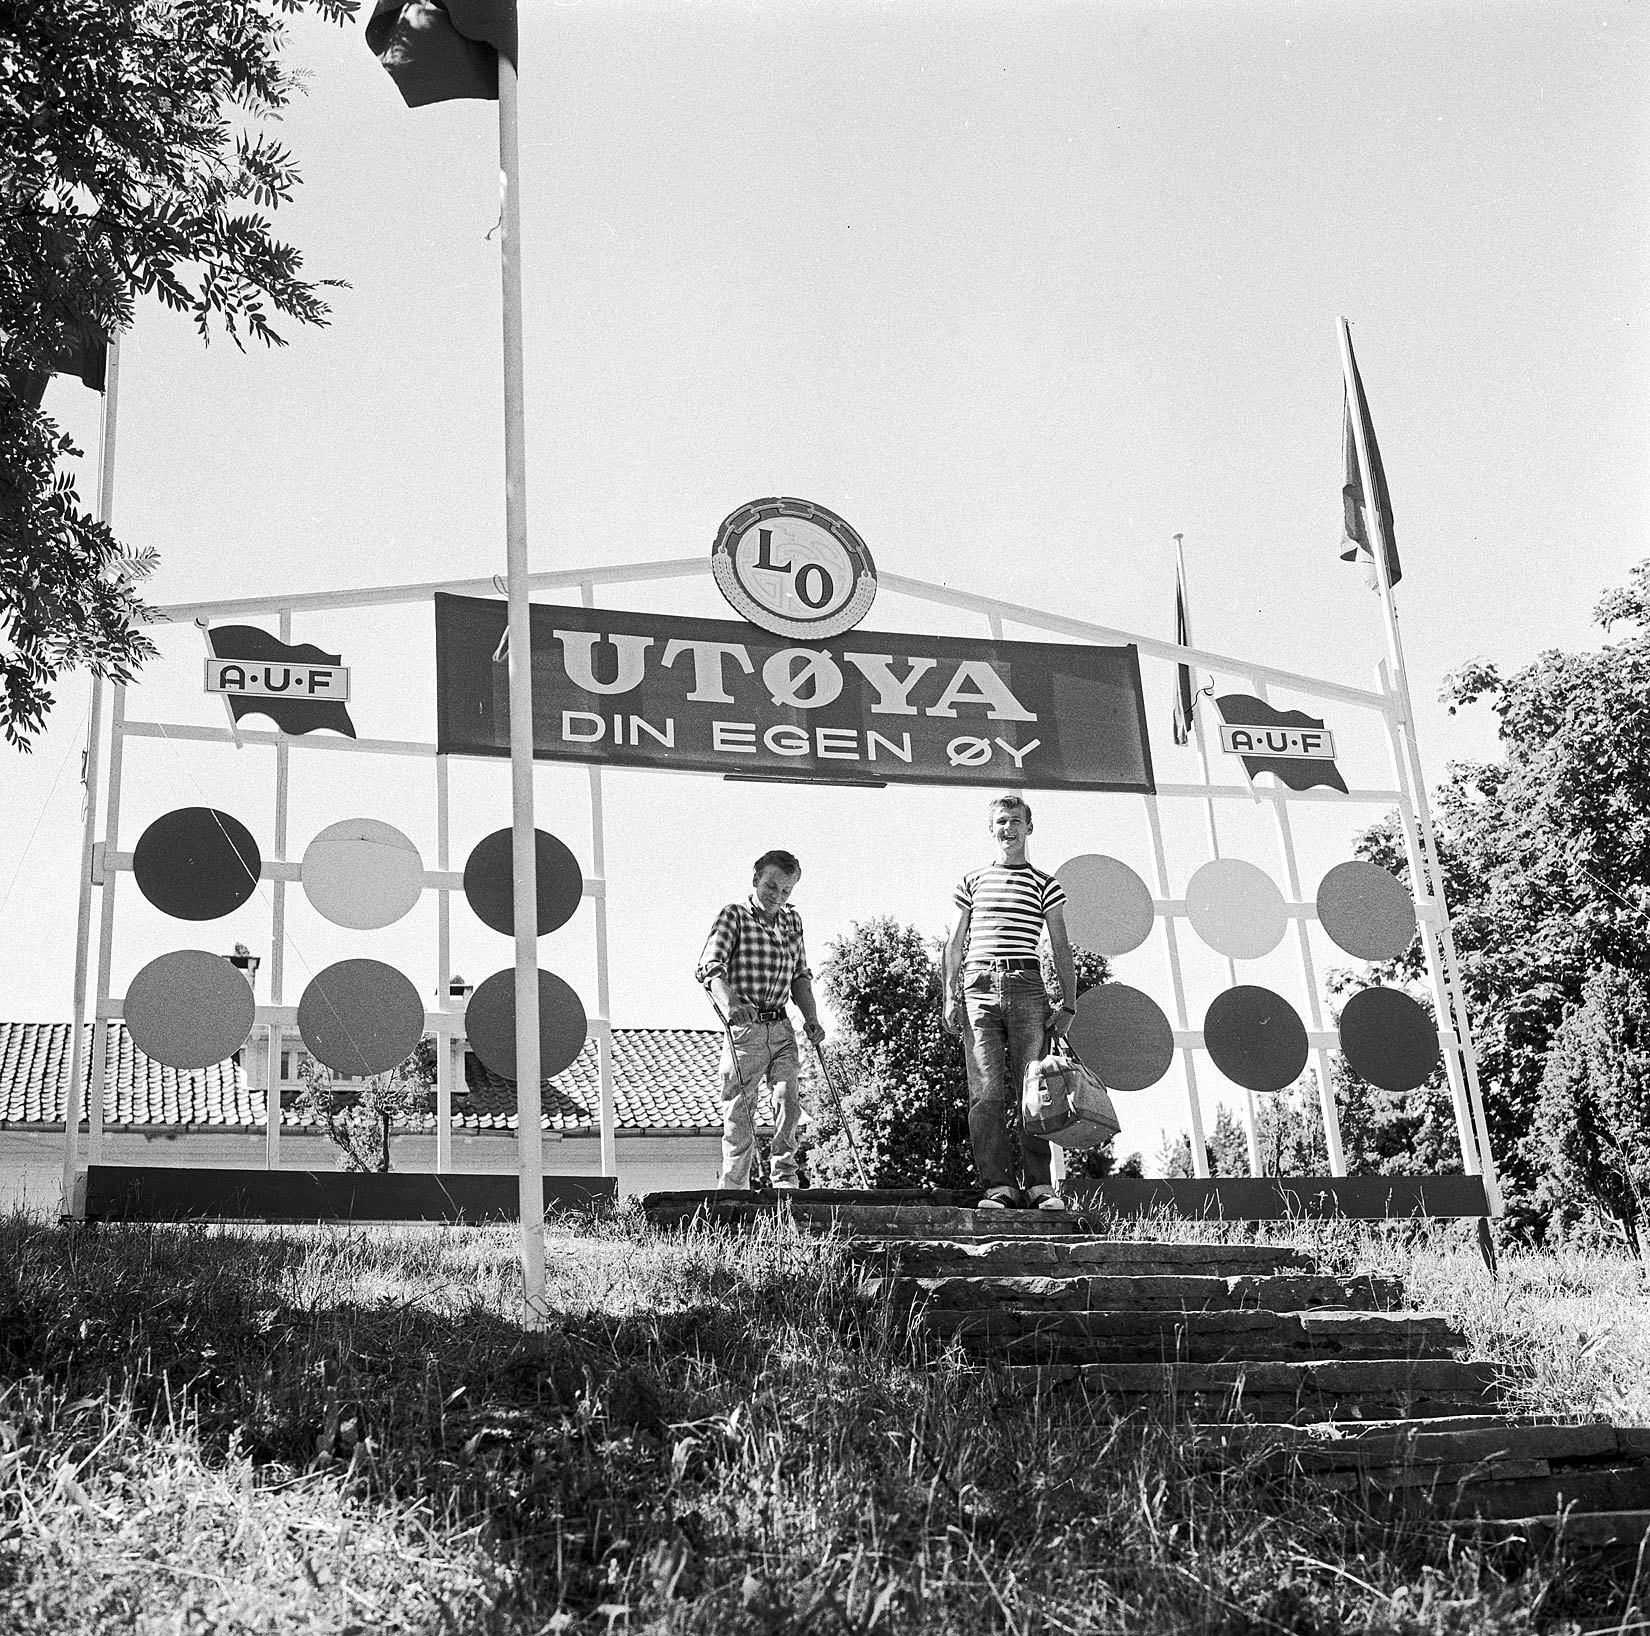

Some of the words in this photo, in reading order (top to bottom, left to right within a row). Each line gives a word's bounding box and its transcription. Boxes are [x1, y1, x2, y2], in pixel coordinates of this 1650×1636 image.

[553, 629, 1037, 721] UTØYA
[562, 711, 674, 747] DIN
[712, 721, 912, 762] EGEN
[946, 736, 1040, 768] ØY
